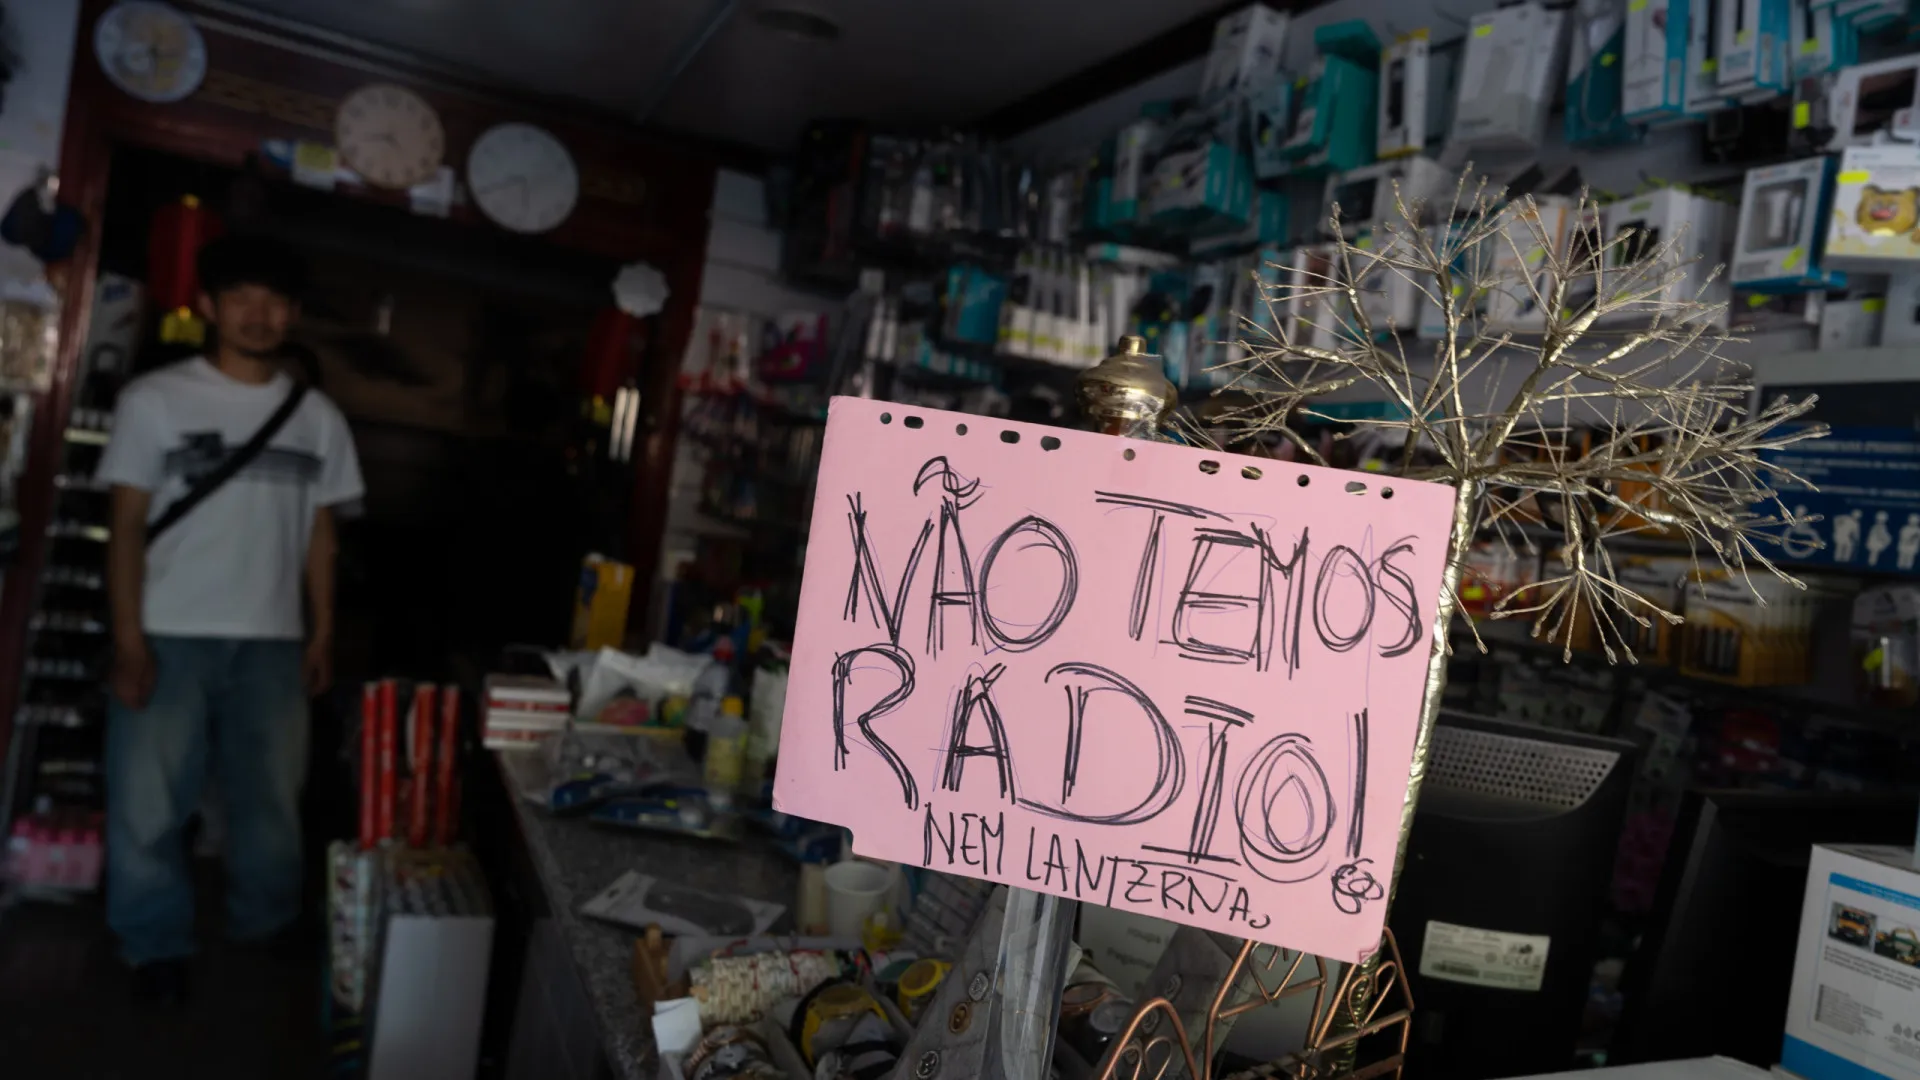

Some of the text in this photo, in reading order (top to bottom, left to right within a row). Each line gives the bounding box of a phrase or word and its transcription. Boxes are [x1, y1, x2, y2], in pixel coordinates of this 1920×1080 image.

[843, 455, 1423, 680] NÃO TEMOS
[831, 643, 1385, 914] RÁDIO!
[922, 802, 1004, 875] NEM
